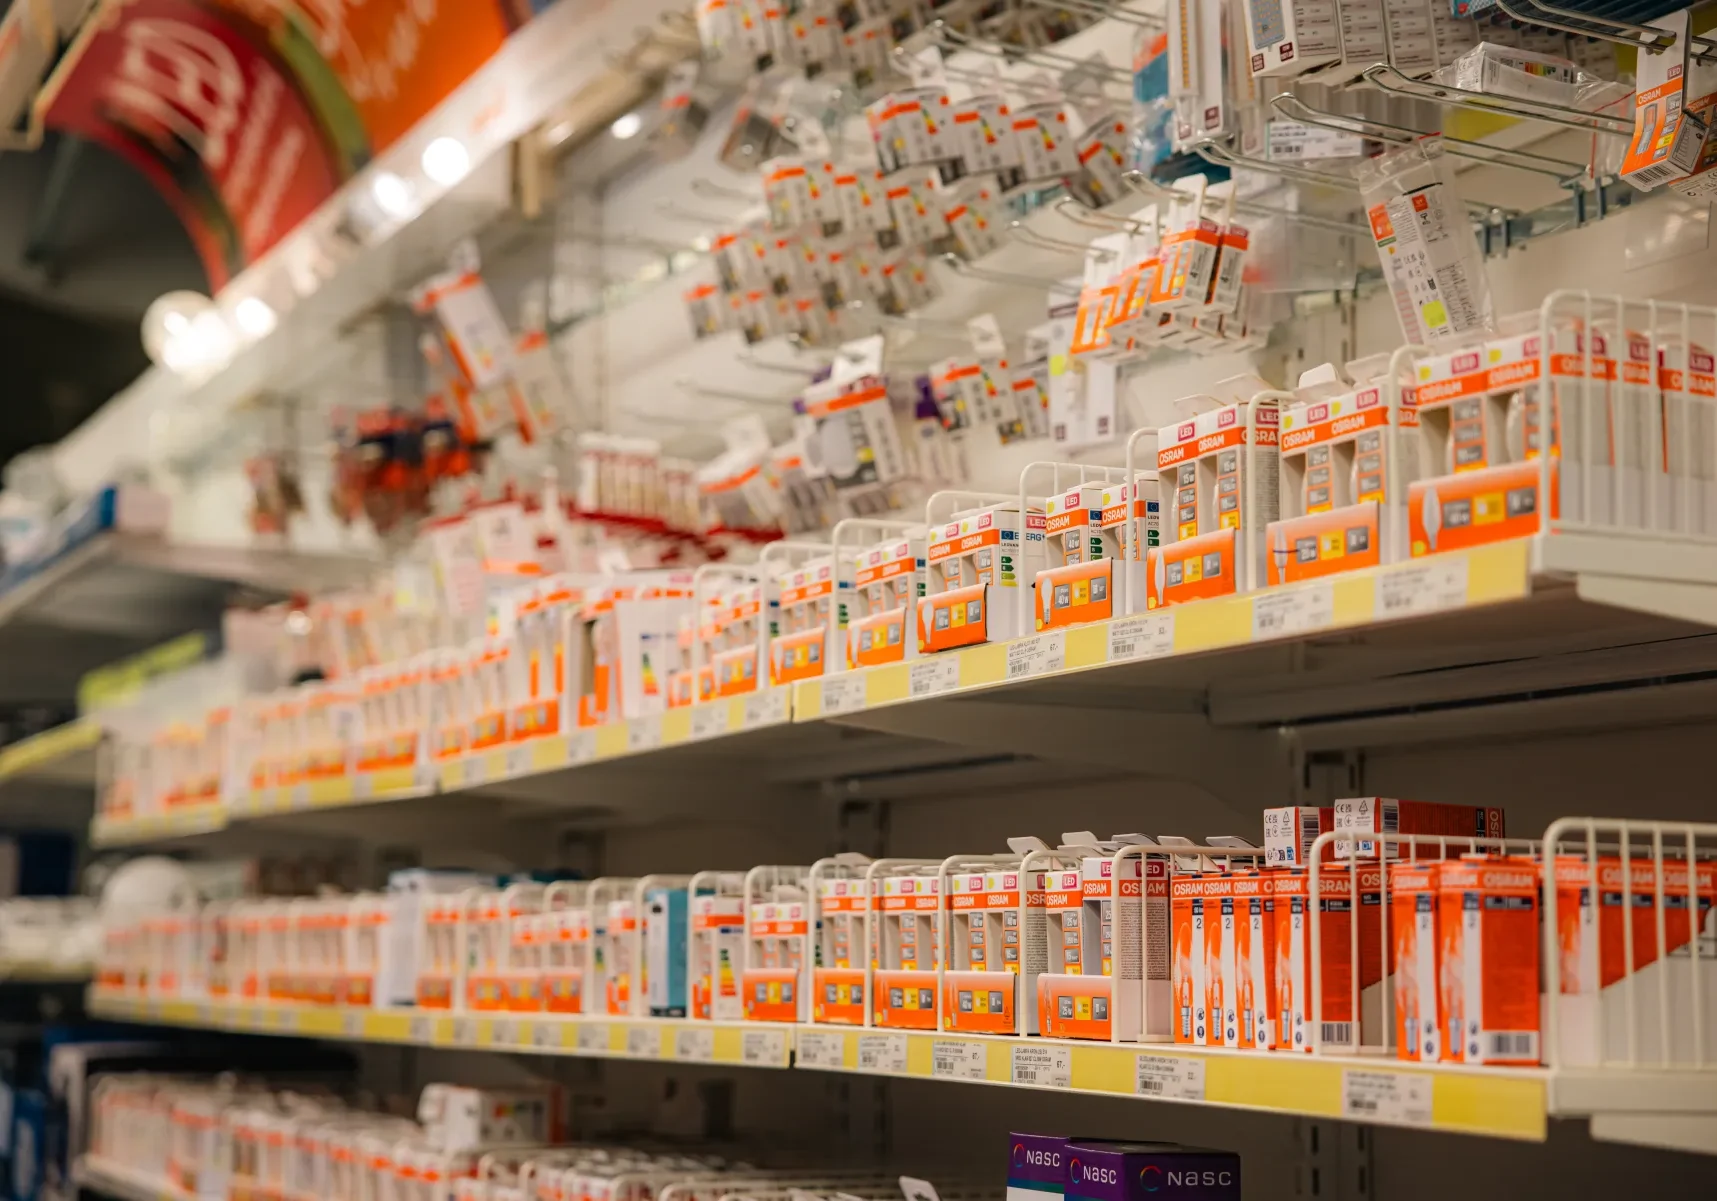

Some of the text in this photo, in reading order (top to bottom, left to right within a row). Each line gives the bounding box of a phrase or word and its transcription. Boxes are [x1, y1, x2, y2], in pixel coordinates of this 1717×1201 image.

[1638, 88, 1661, 104] OSRAM
[1220, 411, 1234, 424] LED
[1309, 406, 1326, 421] LED
[1331, 415, 1365, 435] OSRAM
[1180, 426, 1193, 438] LED
[1283, 428, 1316, 448] OSRAM
[1198, 434, 1225, 452] OSRAM
[1159, 448, 1184, 464] OSRAM
[1066, 496, 1078, 507] LED
[1102, 507, 1127, 522] OSRAM
[980, 516, 990, 527] LED
[1047, 515, 1070, 531] OSRAM
[961, 535, 983, 549] OSRAM
[1014, 533, 1041, 541] EERG
[1102, 865, 1111, 874] LE
[1004, 877, 1015, 887] LED
[1064, 876, 1075, 886] LED
[1233, 880, 1259, 893] OSRAM
[1275, 879, 1301, 892] OSRAM
[1084, 883, 1107, 895] OSRAM
[1122, 882, 1165, 894] OSAM
[1174, 882, 1203, 896] OSRAM
[1204, 881, 1231, 895] OSRAM
[987, 894, 1009, 905] OSRAM
[1046, 894, 1068, 905] OSRAM
[1196, 918, 1202, 929] 2
[1225, 918, 1231, 929] 2
[1253, 918, 1259, 929] 2
[1294, 917, 1300, 928] 2
